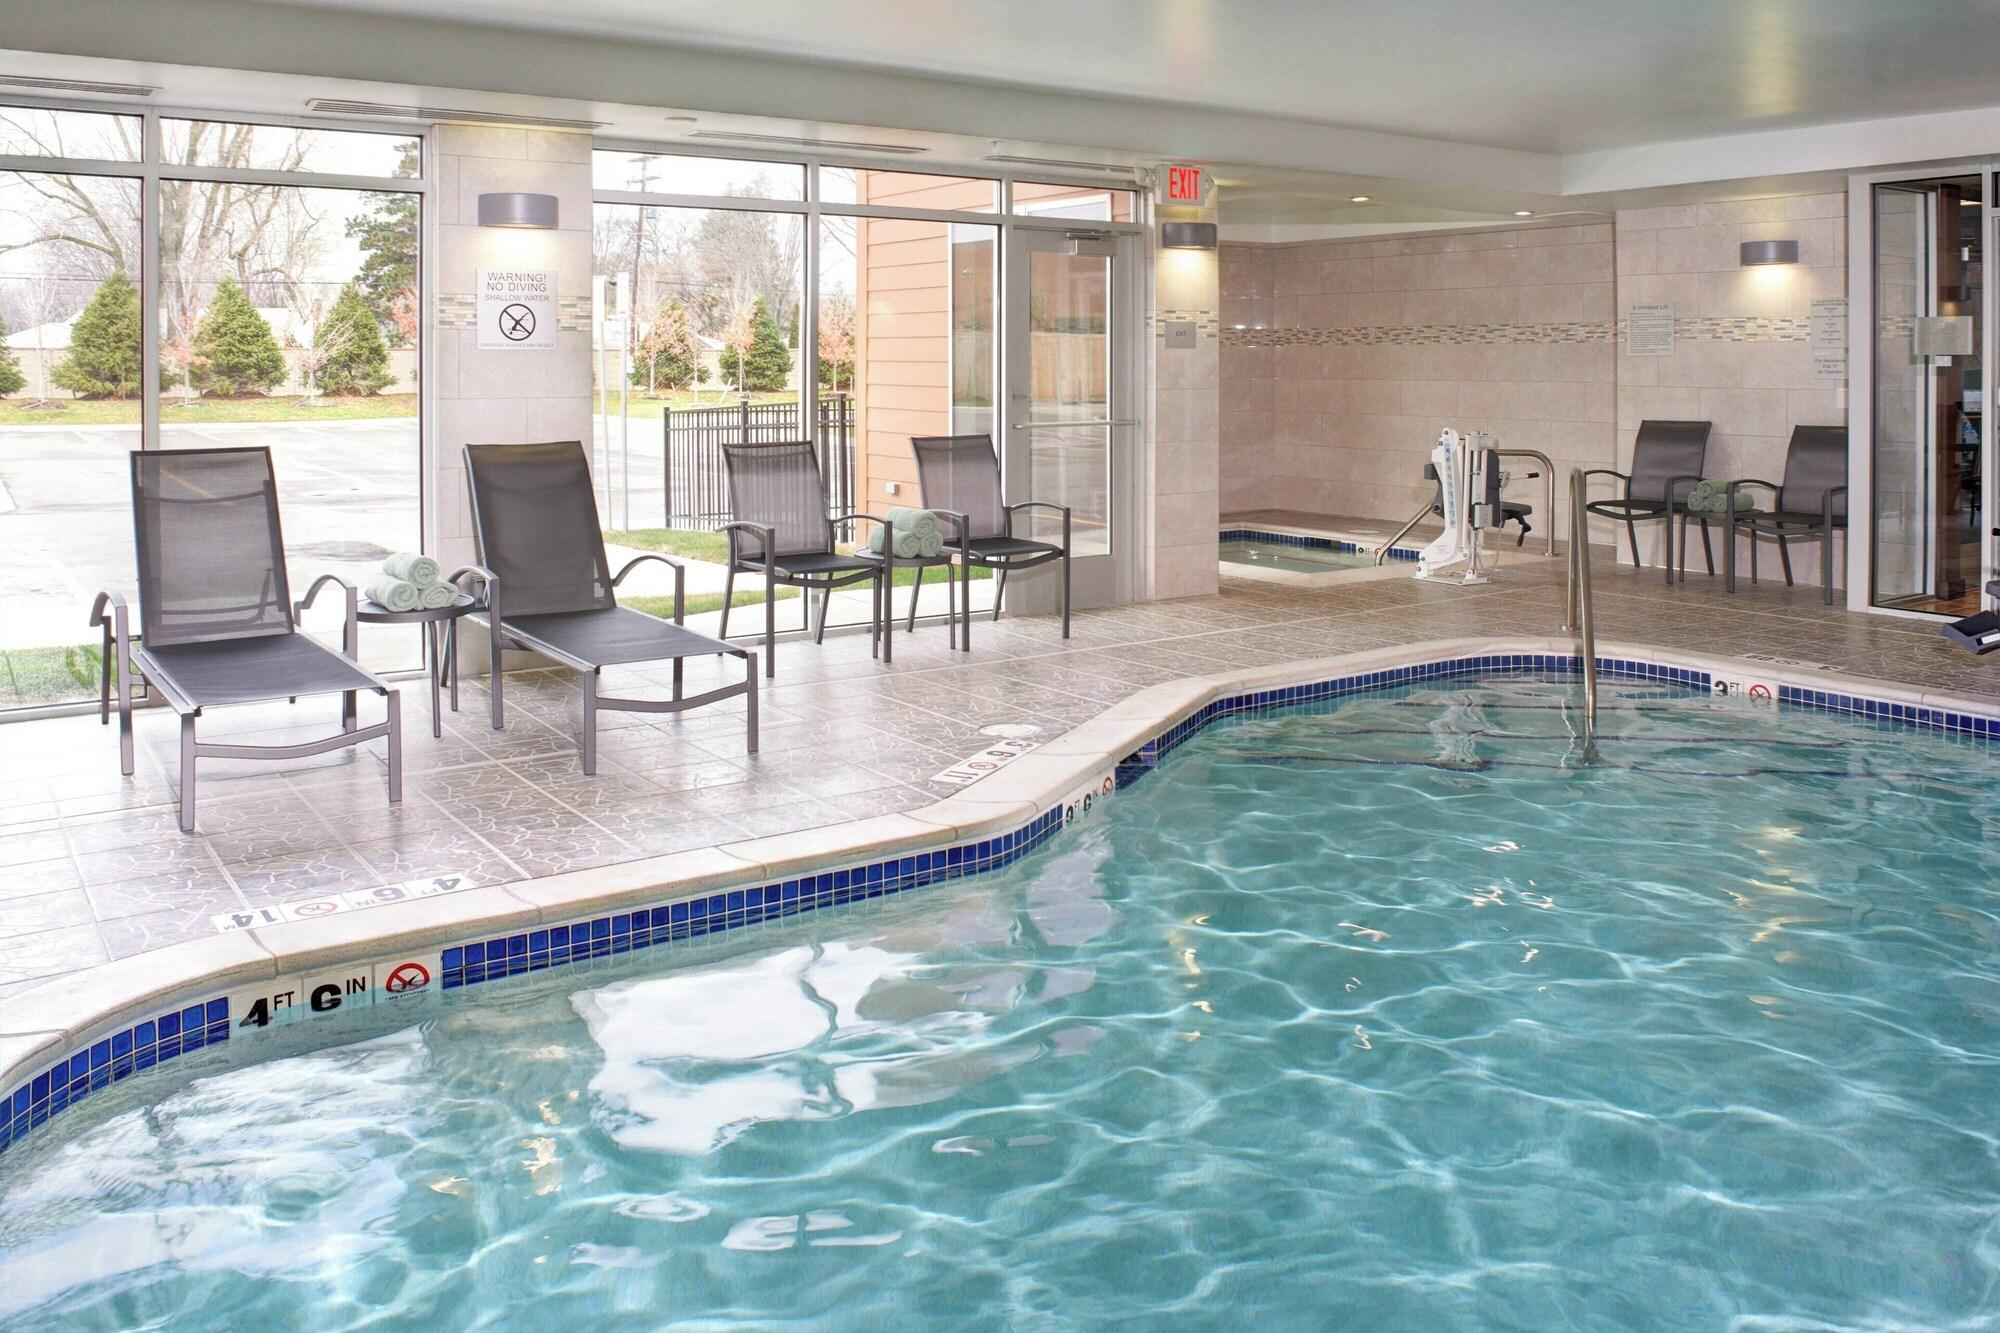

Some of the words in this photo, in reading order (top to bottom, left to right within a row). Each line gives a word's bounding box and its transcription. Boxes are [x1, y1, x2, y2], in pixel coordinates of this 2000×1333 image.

[1168, 167, 1200, 200] EXIT
[487, 271, 547, 283] WARNING!
[486, 282, 504, 291] NO
[508, 282, 547, 292] DIVING
[525, 294, 550, 302] WATER
[432, 877, 461, 891] 4
[372, 887, 406, 901] 6
[238, 997, 274, 1028] 4
[273, 990, 295, 1011] FT
[346, 976, 366, 996] IN
